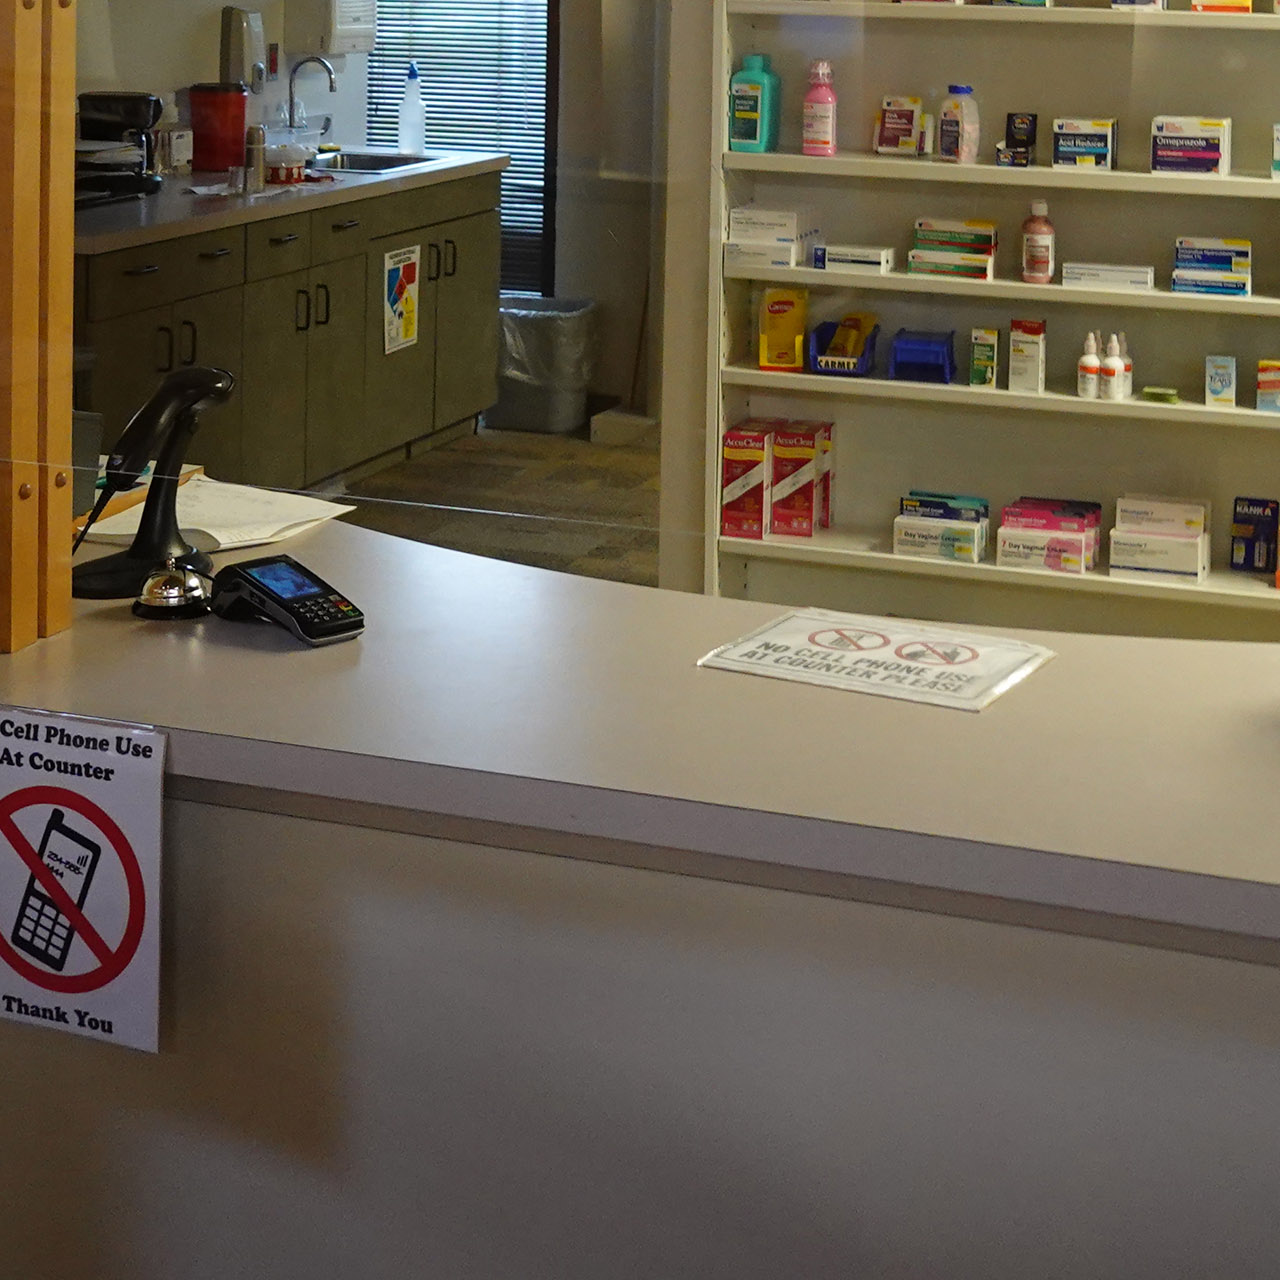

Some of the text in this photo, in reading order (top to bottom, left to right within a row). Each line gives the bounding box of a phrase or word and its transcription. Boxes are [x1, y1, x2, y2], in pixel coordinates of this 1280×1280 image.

[1058, 139, 1105, 148] Acid Reducer
[1156, 136, 1207, 147] Omeprazole
[818, 359, 858, 370] CARMEX
[725, 438, 763, 448] AccuClear
[776, 436, 814, 447] AccuClear
[904, 531, 916, 539] Day
[917, 531, 939, 540] Vaginal
[1022, 543, 1046, 552] Vaginal
[755, 640, 976, 685] NO CELL PHONE USE
[738, 649, 964, 693] AT COUNTER PLEASE
[0, 718, 40, 742] Cell
[45, 725, 110, 752] Phone
[115, 737, 153, 759] Use
[28, 751, 115, 782] Counter
[1, 994, 114, 1034] Thank You
